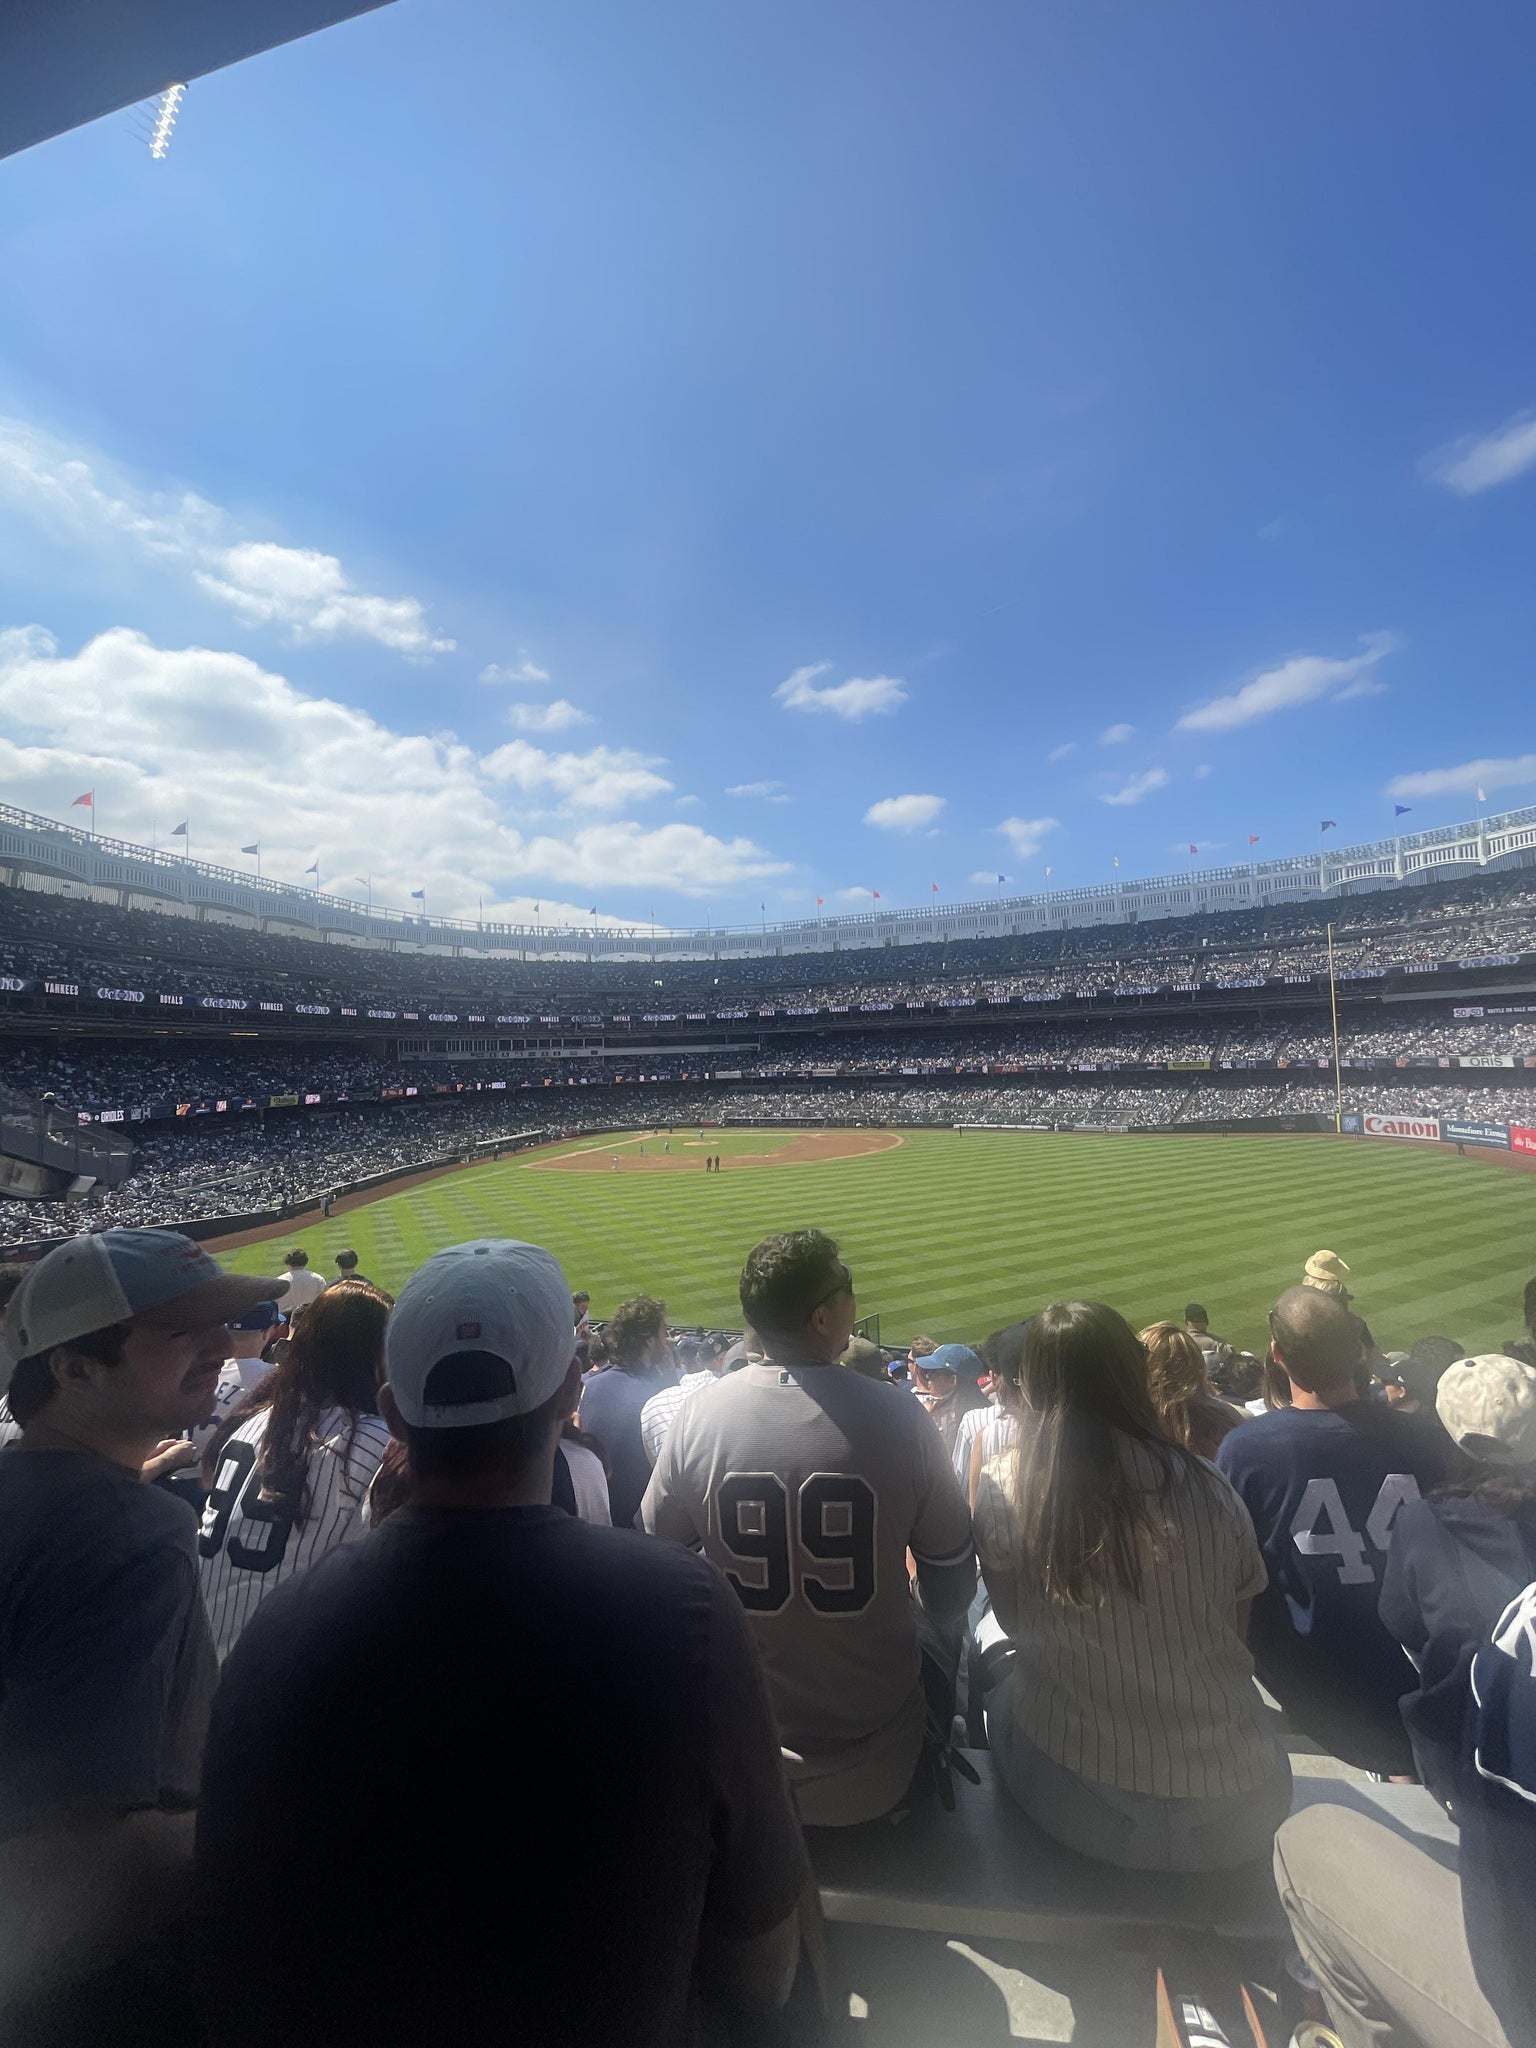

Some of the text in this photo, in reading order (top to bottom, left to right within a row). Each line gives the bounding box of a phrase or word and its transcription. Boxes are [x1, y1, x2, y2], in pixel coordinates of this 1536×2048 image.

[1403, 963, 1439, 974] YANKEES
[1284, 975, 1311, 984] ROYALS
[45, 982, 79, 995] YANKEES
[1172, 983, 1200, 991] YANKEES
[160, 994, 183, 1005] ROYALS
[1076, 990, 1098, 998] ROYALS
[1470, 1057, 1503, 1067] ORIS
[1365, 1117, 1438, 1138] Canon
[715, 1471, 878, 1617] 99
